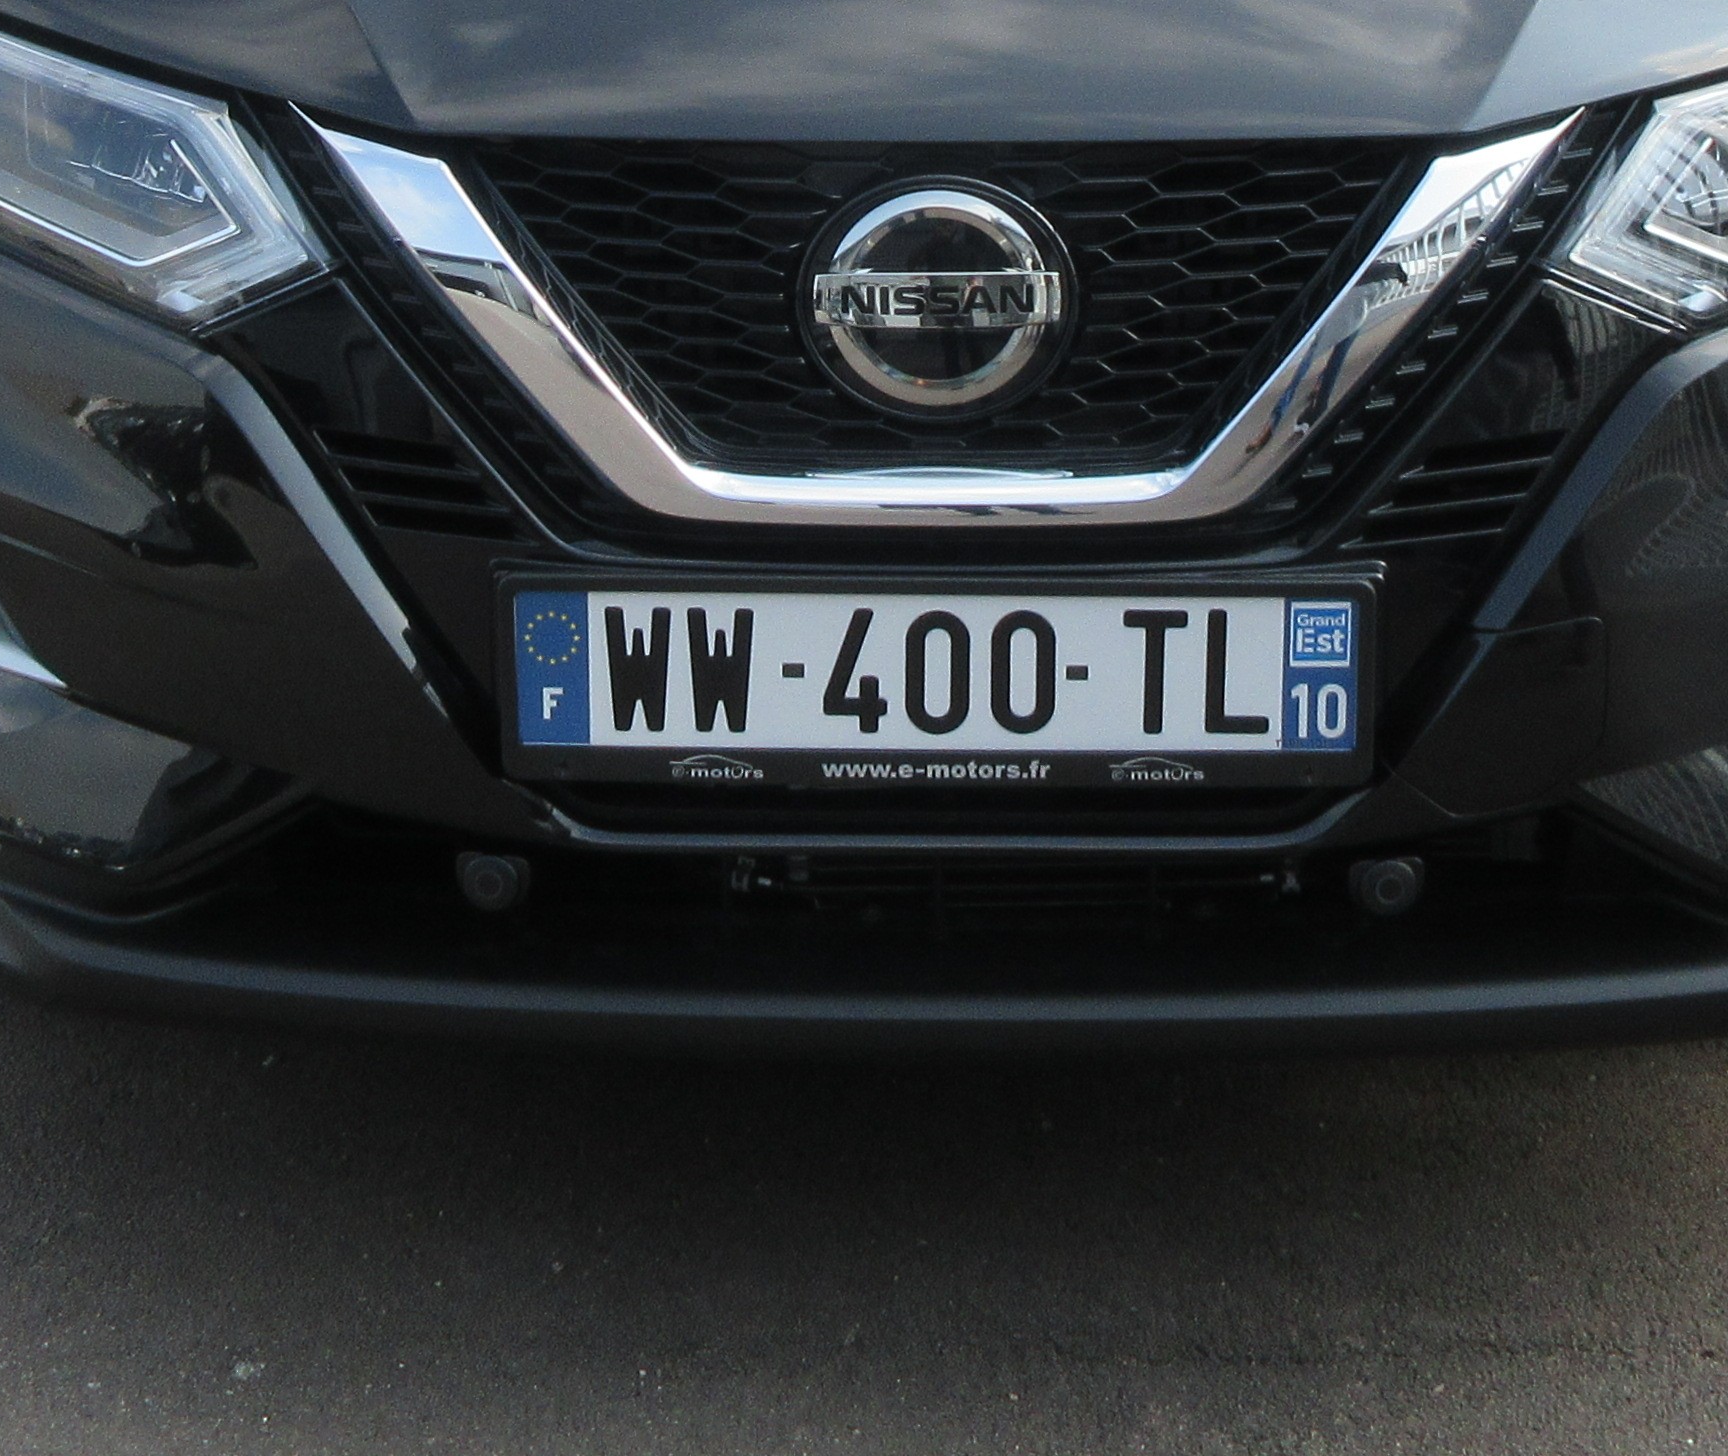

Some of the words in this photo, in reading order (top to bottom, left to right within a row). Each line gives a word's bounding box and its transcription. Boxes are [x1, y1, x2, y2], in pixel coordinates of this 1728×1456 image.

[840, 285, 1035, 316] NISSAN
[1297, 613, 1346, 627] Grand
[1296, 627, 1346, 654] Est
[604, 606, 1270, 735] WW-400-TL
[542, 686, 564, 720] F
[1290, 682, 1348, 739] 10
[821, 760, 1052, 779] www.e-motors.fr
